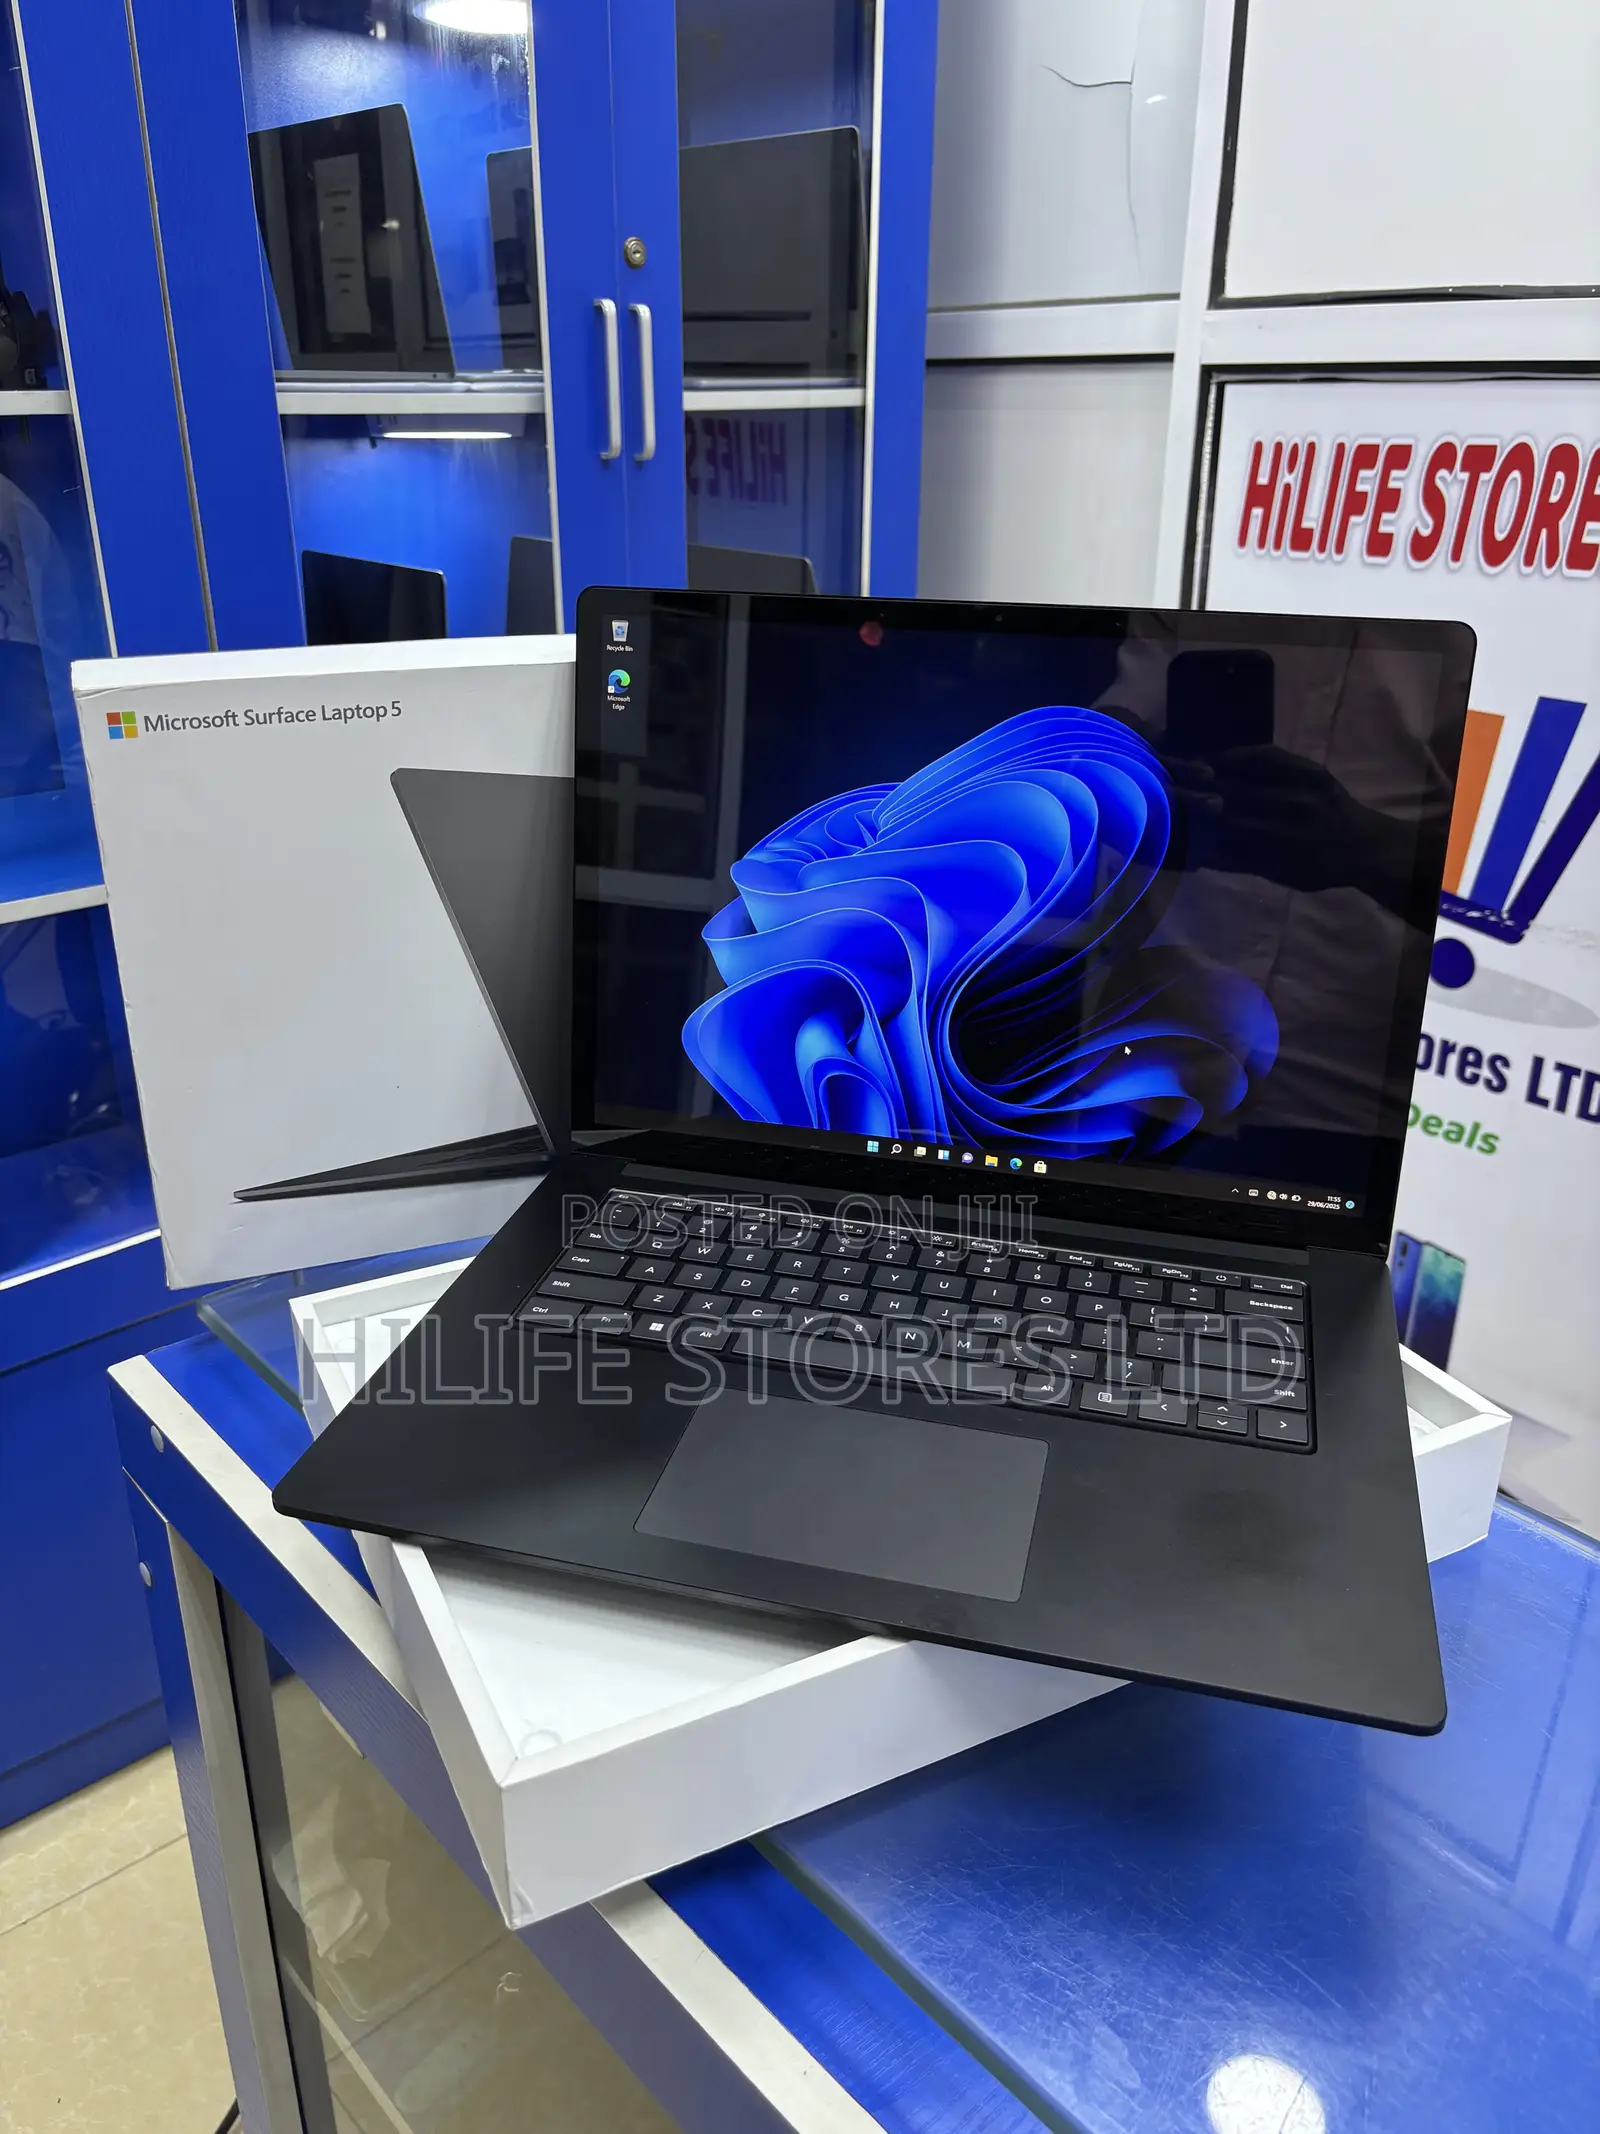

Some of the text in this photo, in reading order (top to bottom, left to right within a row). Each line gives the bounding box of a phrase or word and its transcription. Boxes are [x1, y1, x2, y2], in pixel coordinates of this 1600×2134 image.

[1238, 440, 1413, 558] HiLIFE
[606, 644, 624, 652] Recycle
[143, 701, 402, 732] Microsoft Surface Laptop 5
[1307, 1201, 1340, 1210] 29/06/2025
[653, 1294, 664, 1302] Z
[1040, 1296, 1052, 1304] O
[889, 1301, 900, 1309] H
[1250, 1300, 1293, 1310] Backspace
[854, 1324, 863, 1332] B
[905, 1332, 916, 1340] N
[1271, 1358, 1294, 1366] Enter
[1274, 1389, 1295, 1397] Shift
